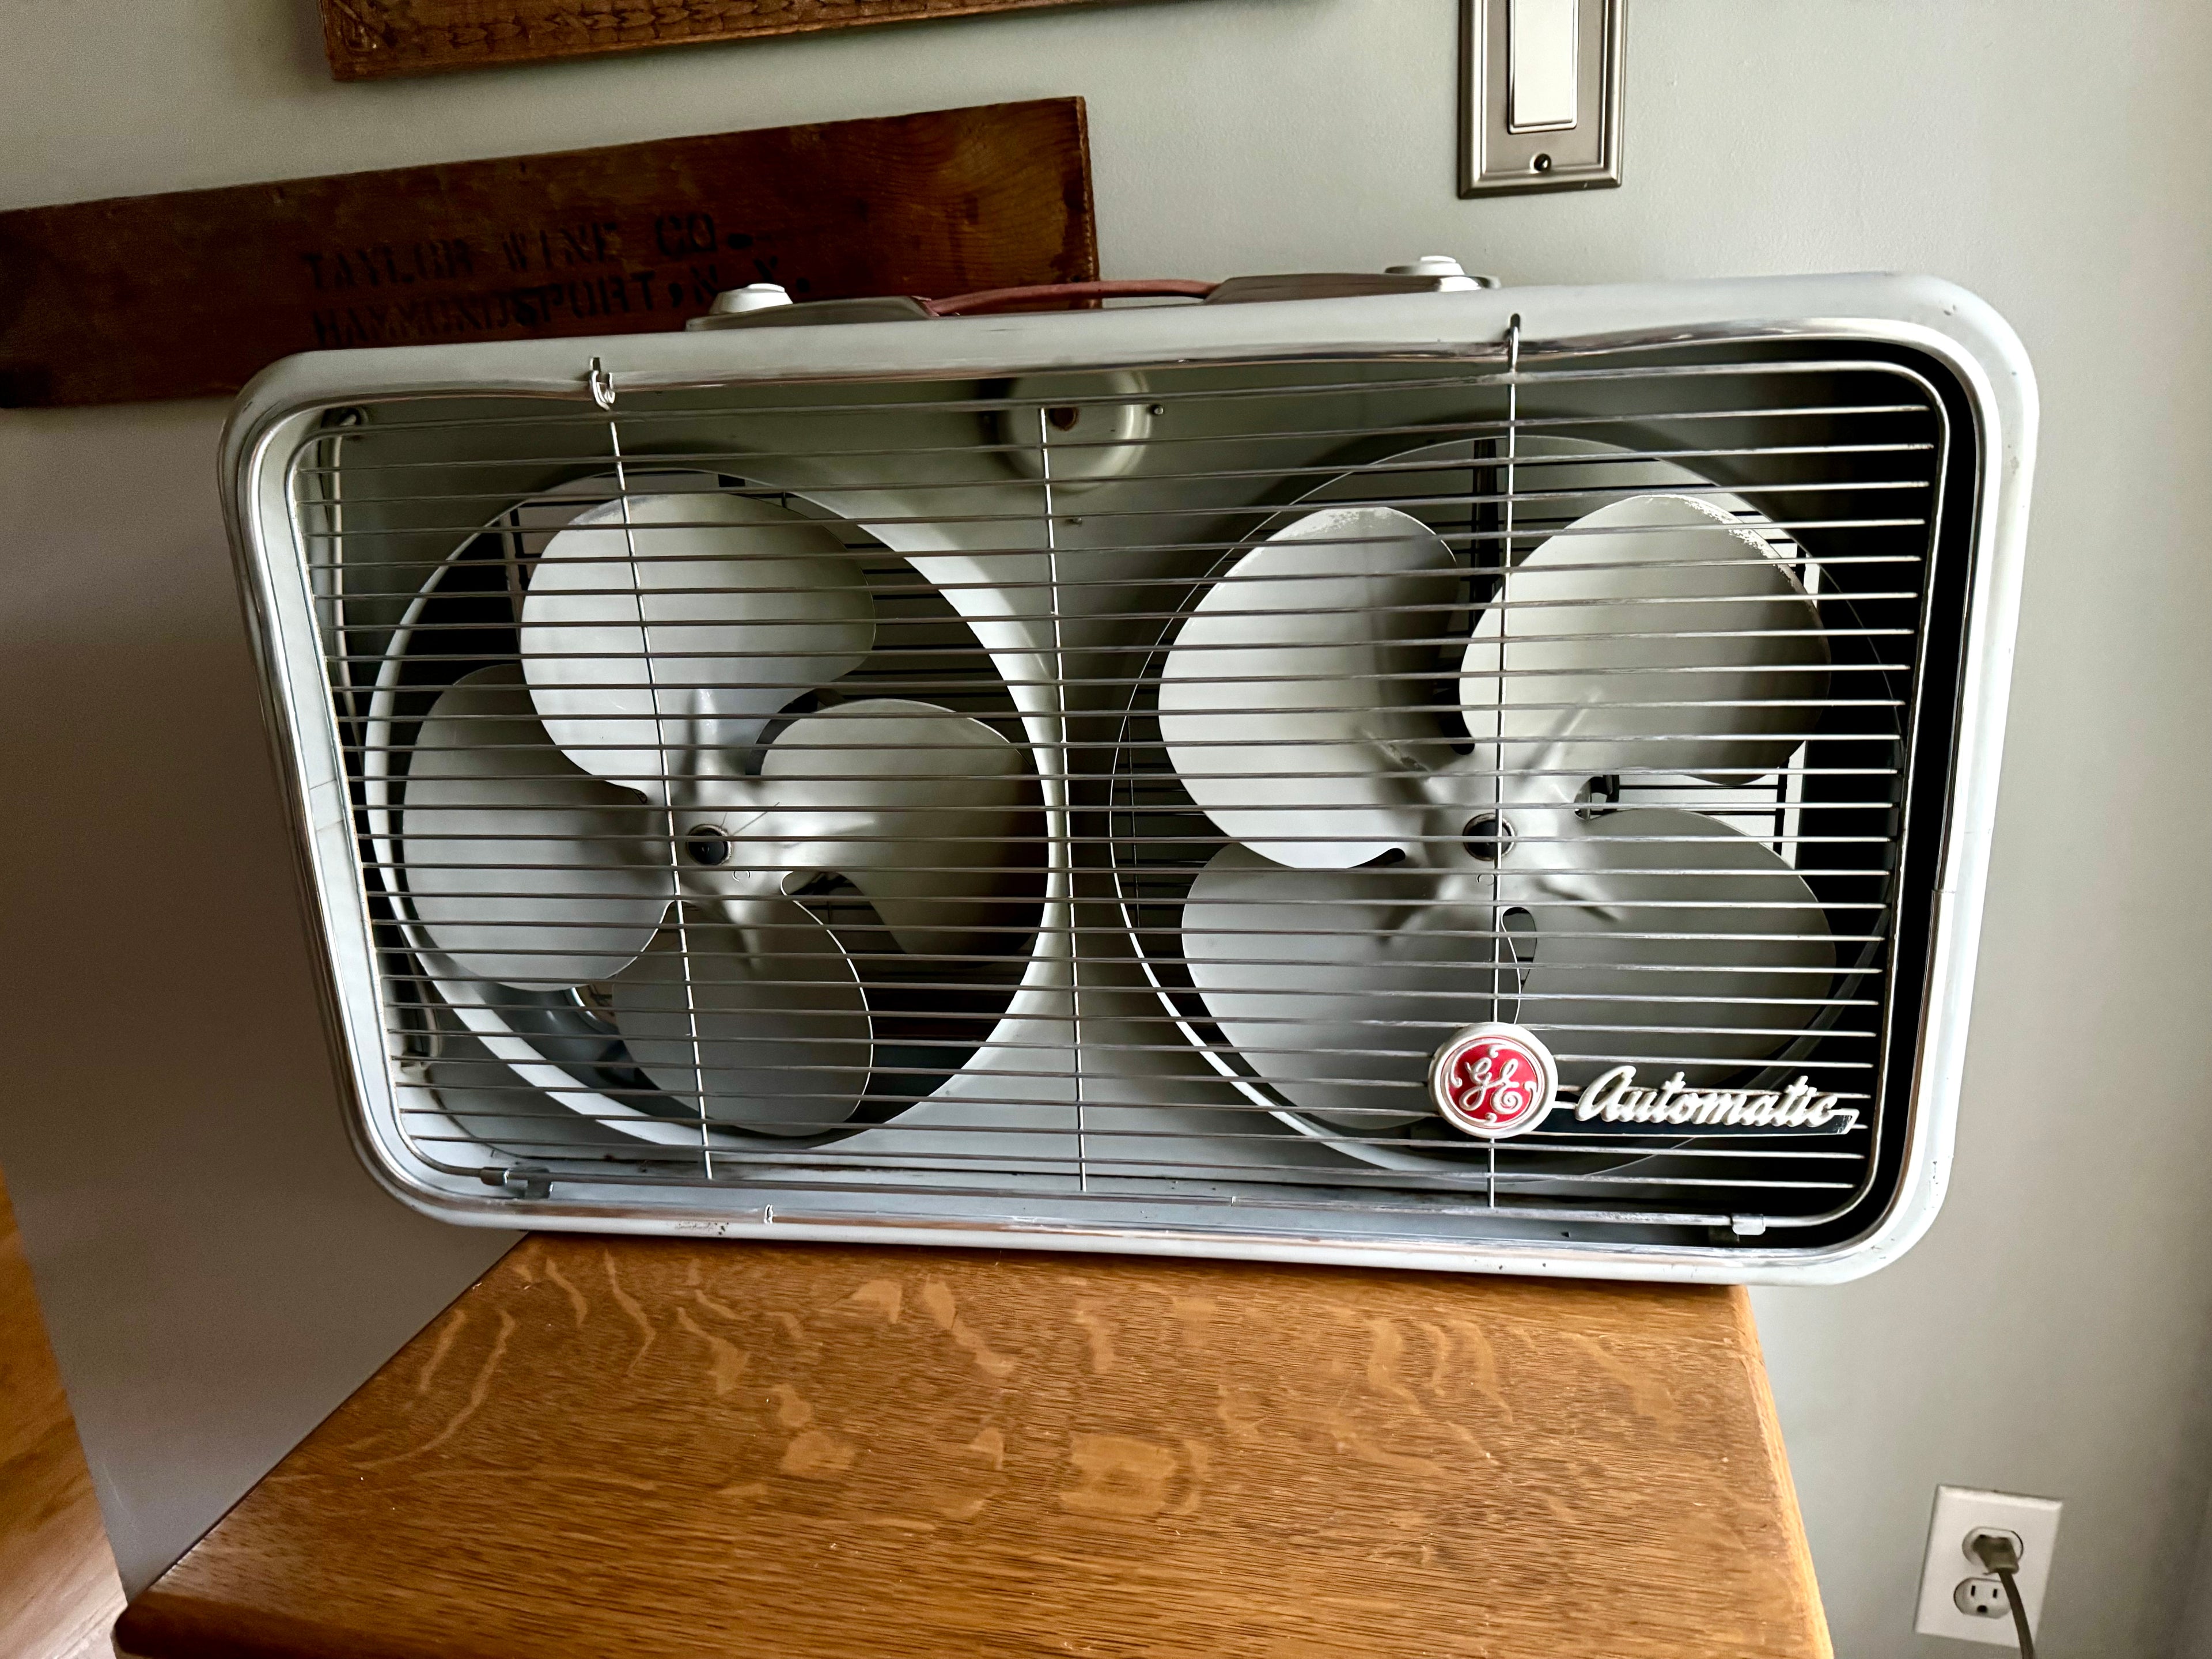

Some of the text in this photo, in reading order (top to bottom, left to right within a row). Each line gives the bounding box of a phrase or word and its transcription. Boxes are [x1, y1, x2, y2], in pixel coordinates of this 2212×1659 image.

[302, 240, 475, 289] TAYLOR
[501, 220, 619, 273] WINE
[1573, 1065, 1841, 1128] Automatic
